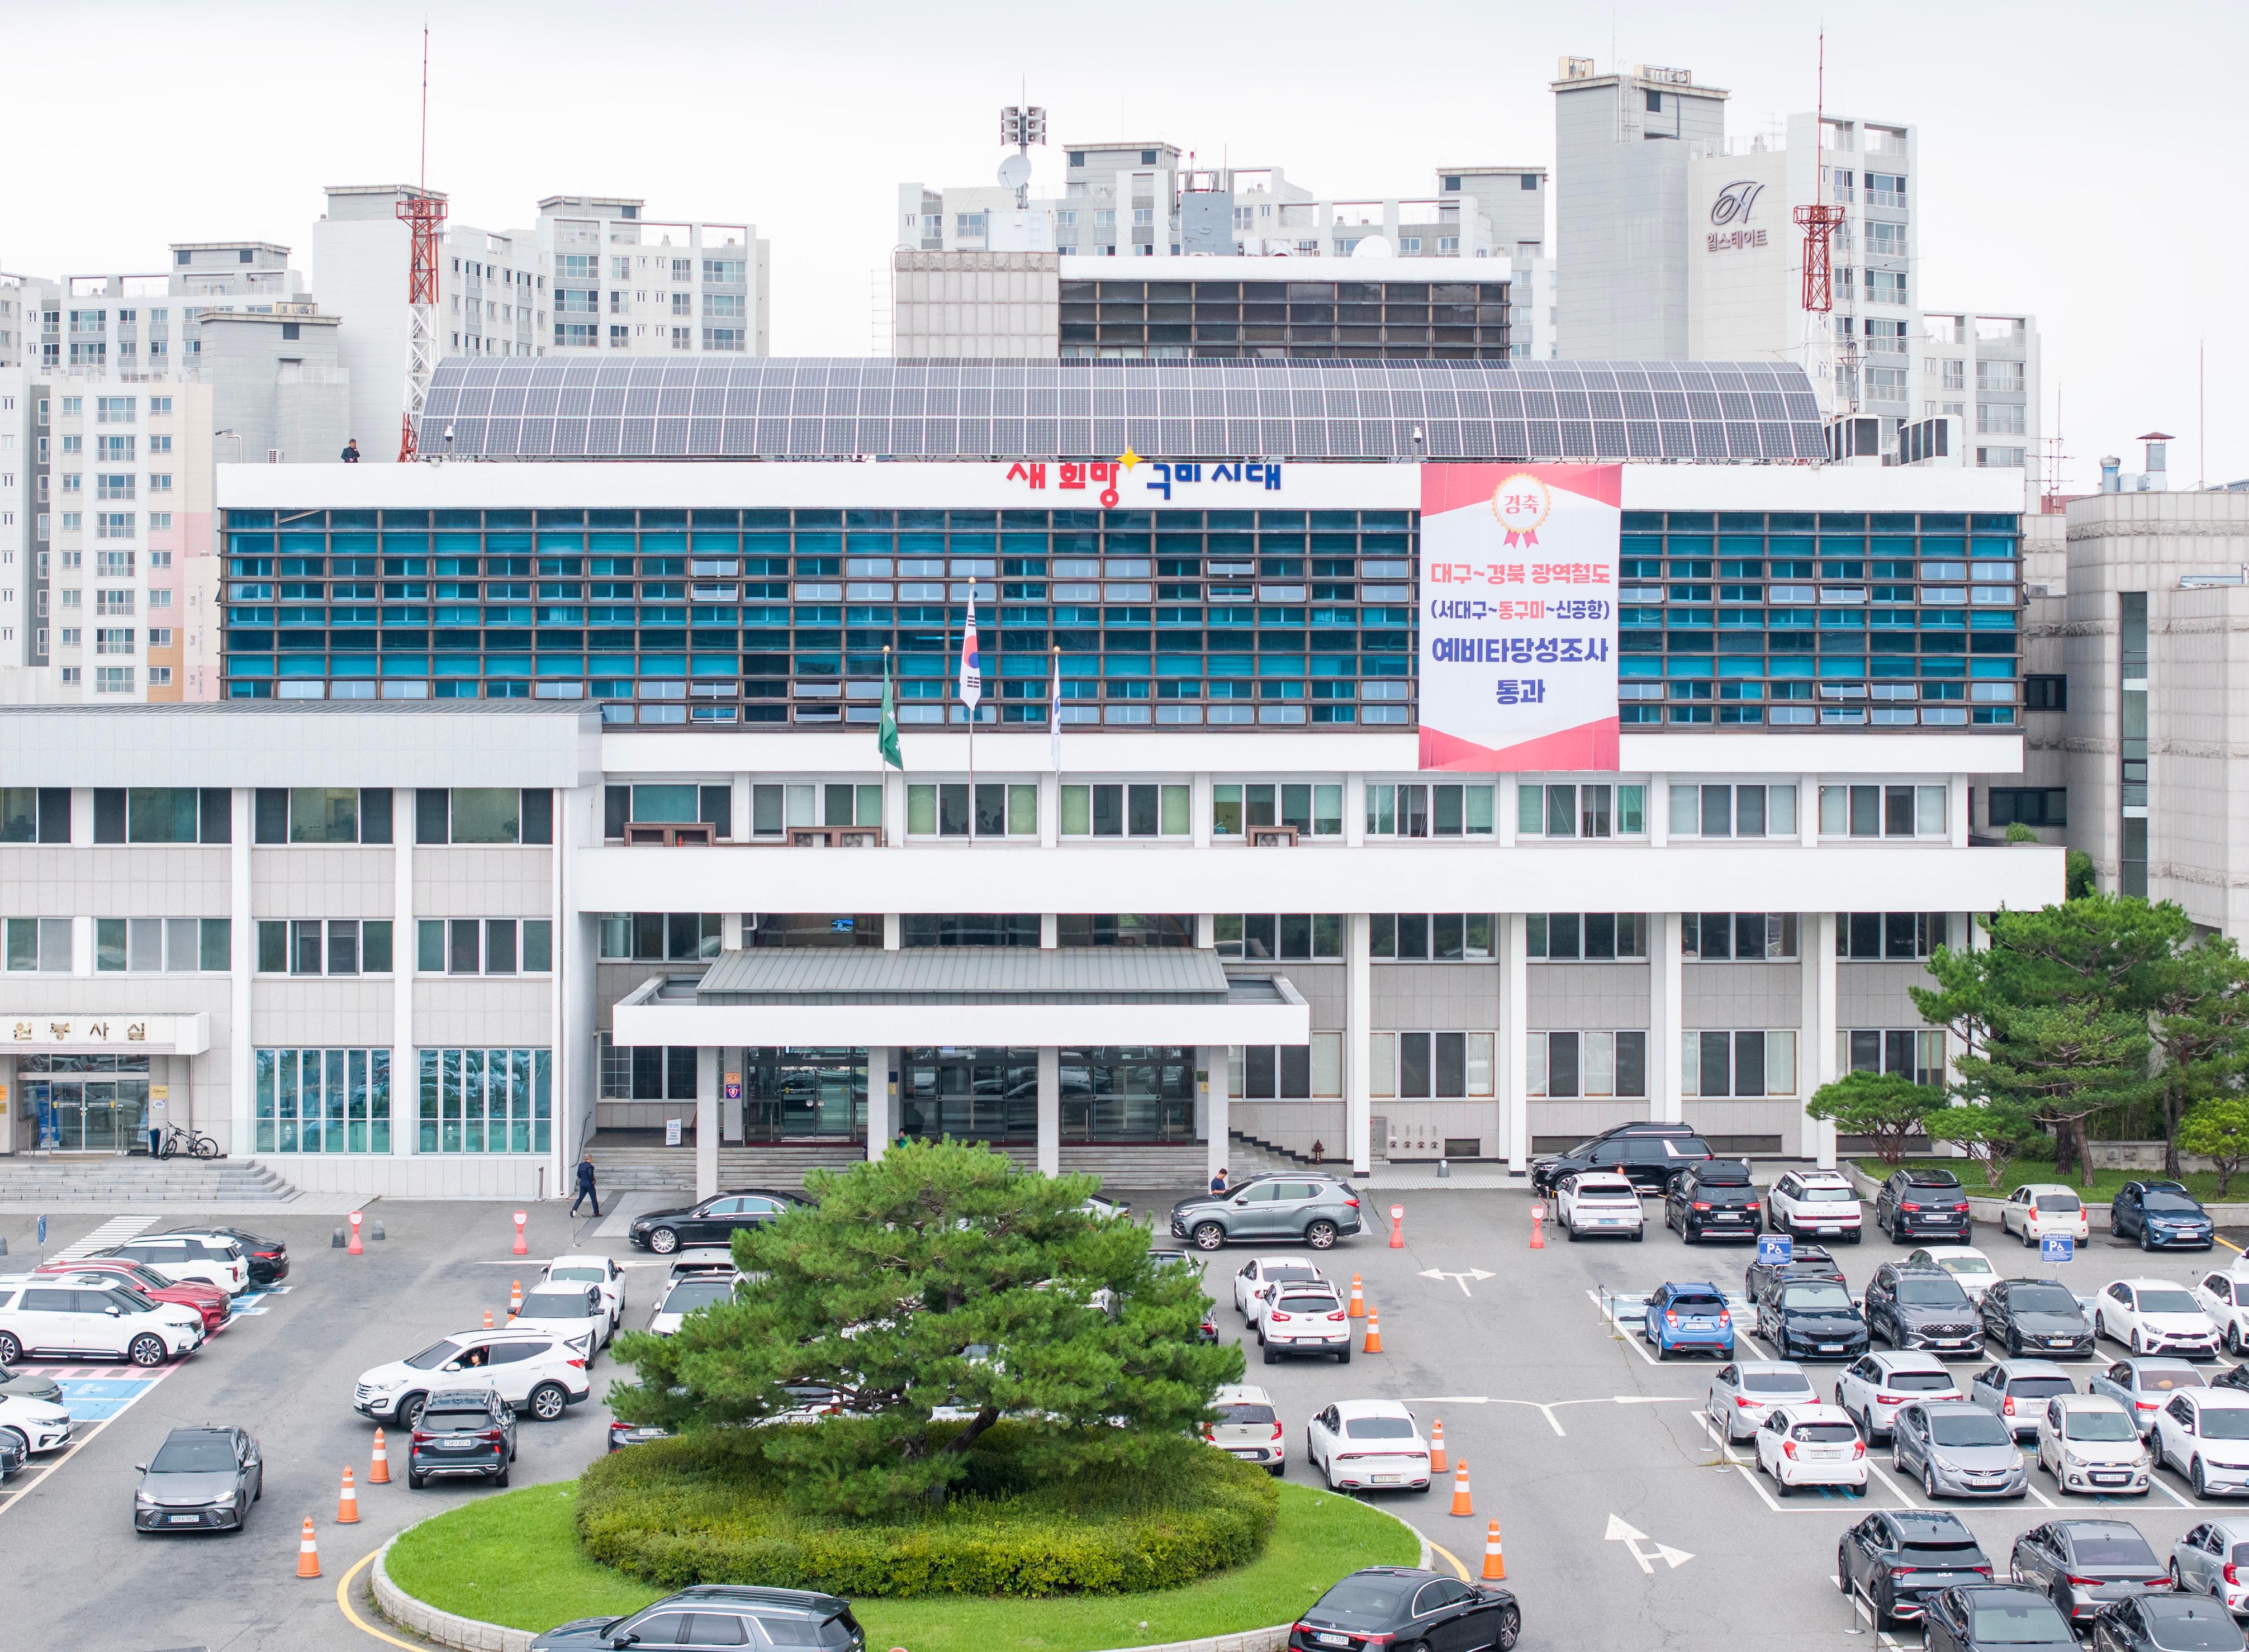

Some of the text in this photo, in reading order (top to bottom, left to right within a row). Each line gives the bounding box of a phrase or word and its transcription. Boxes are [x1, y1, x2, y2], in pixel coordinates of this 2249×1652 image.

[1707, 230, 1767, 251] 힐스테이트
[1007, 463, 1281, 507] 새 희망 구미 시대
[1505, 495, 1539, 514] 경축
[1431, 563, 1610, 585] 대구~경북 광역철도
[1431, 600, 1610, 620] (서대구~동구미~신공항)
[1432, 638, 1608, 663] 예비타당성조사
[1496, 680, 1545, 705] 통과
[1767, 1243, 1776, 1254] P
[2049, 1241, 2057, 1252] P
